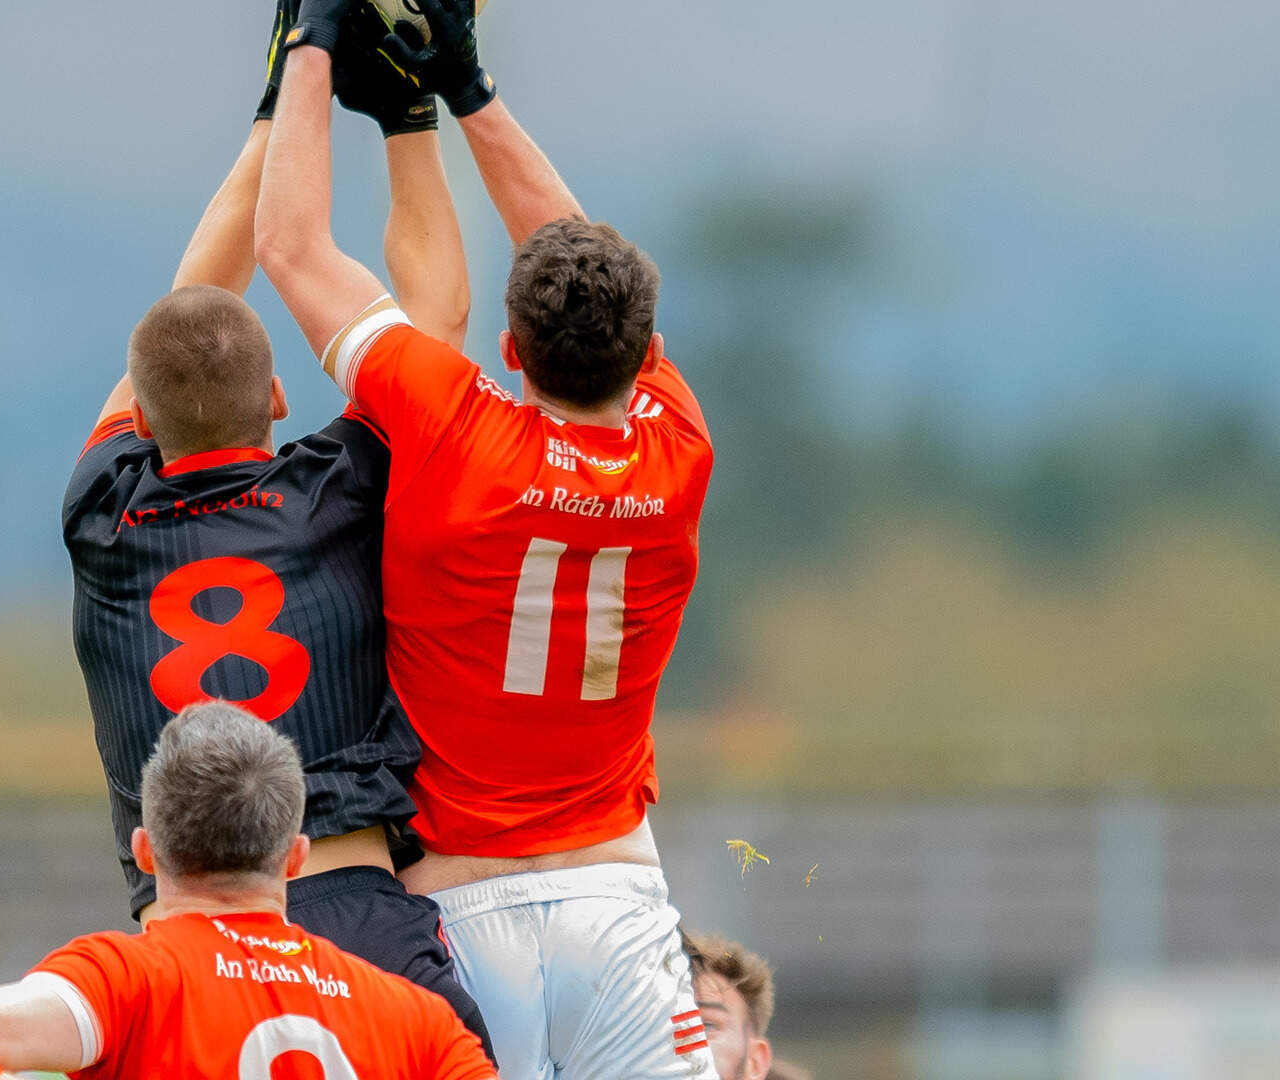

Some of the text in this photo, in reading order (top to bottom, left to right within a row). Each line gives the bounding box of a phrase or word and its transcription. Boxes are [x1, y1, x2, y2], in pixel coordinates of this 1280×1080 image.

[546, 451, 577, 472] Oil
[550, 486, 605, 518] Ráth
[502, 537, 633, 701] 11
[149, 556, 311, 722] 8
[216, 952, 244, 979] An
